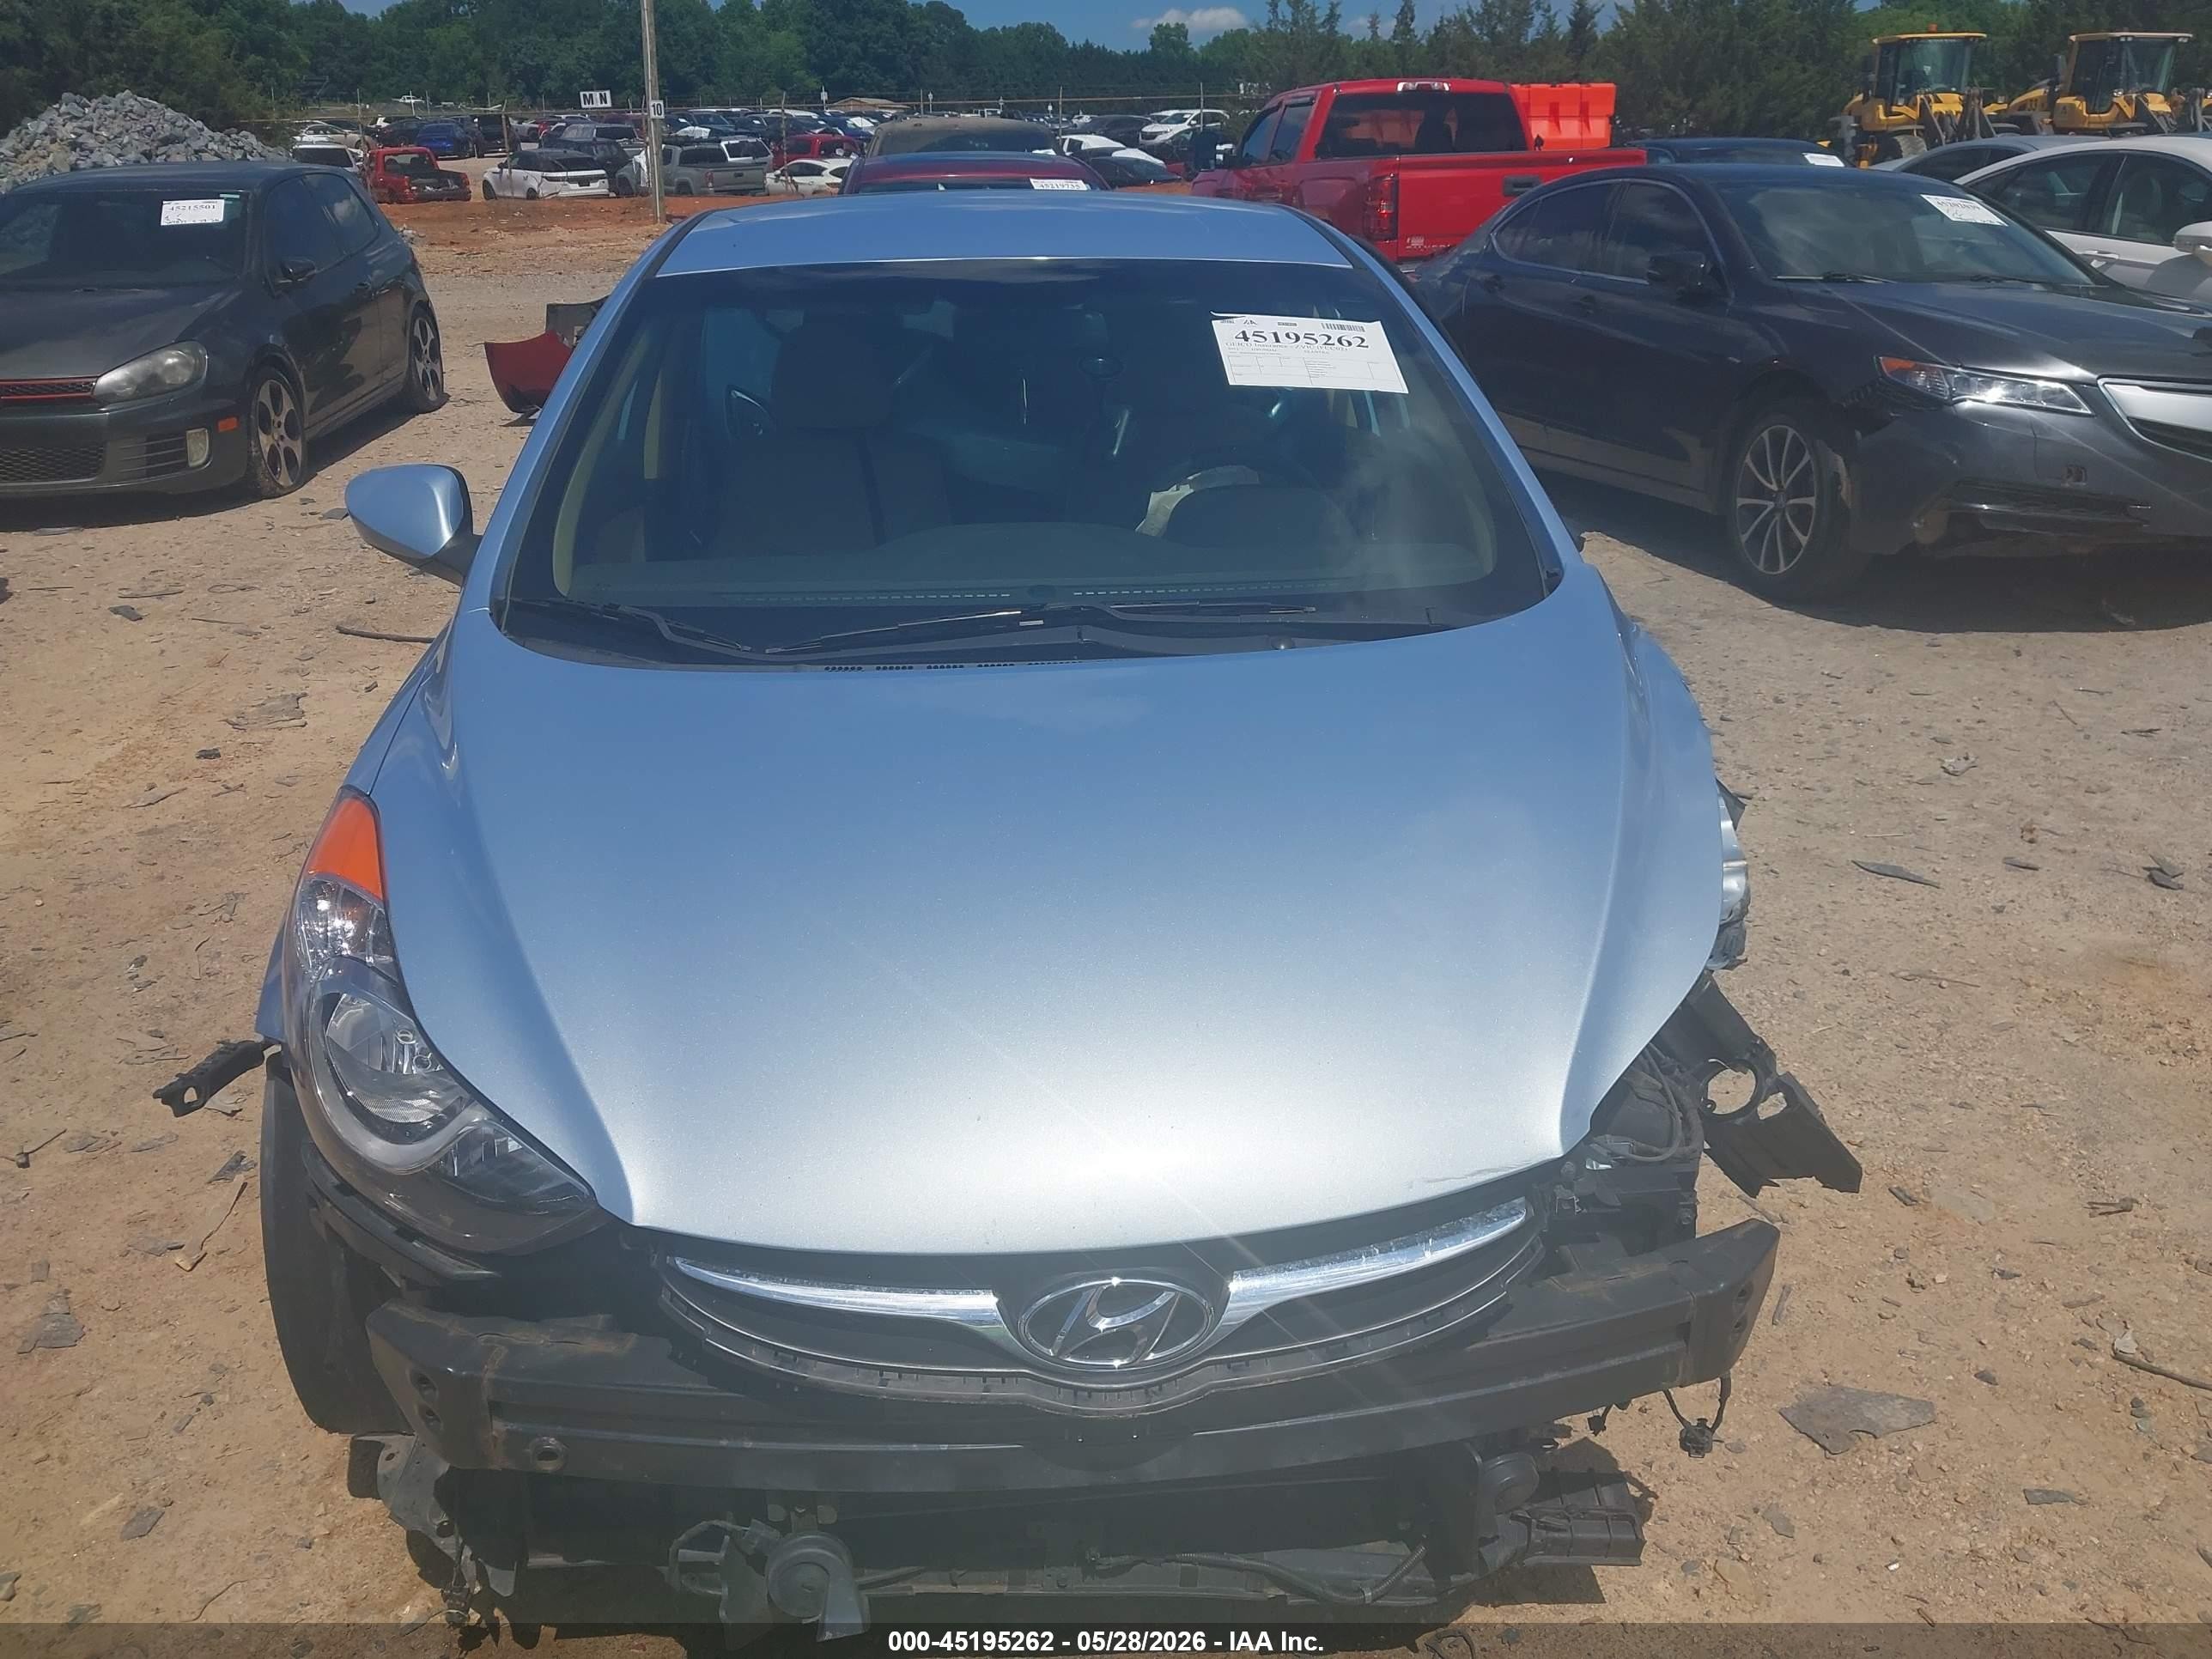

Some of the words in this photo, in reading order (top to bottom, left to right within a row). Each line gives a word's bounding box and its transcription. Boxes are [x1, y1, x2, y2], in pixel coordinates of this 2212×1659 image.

[582, 93, 594, 106] M
[599, 92, 608, 105] N
[653, 103, 662, 116] 10
[1234, 330, 1370, 349] 45195262
